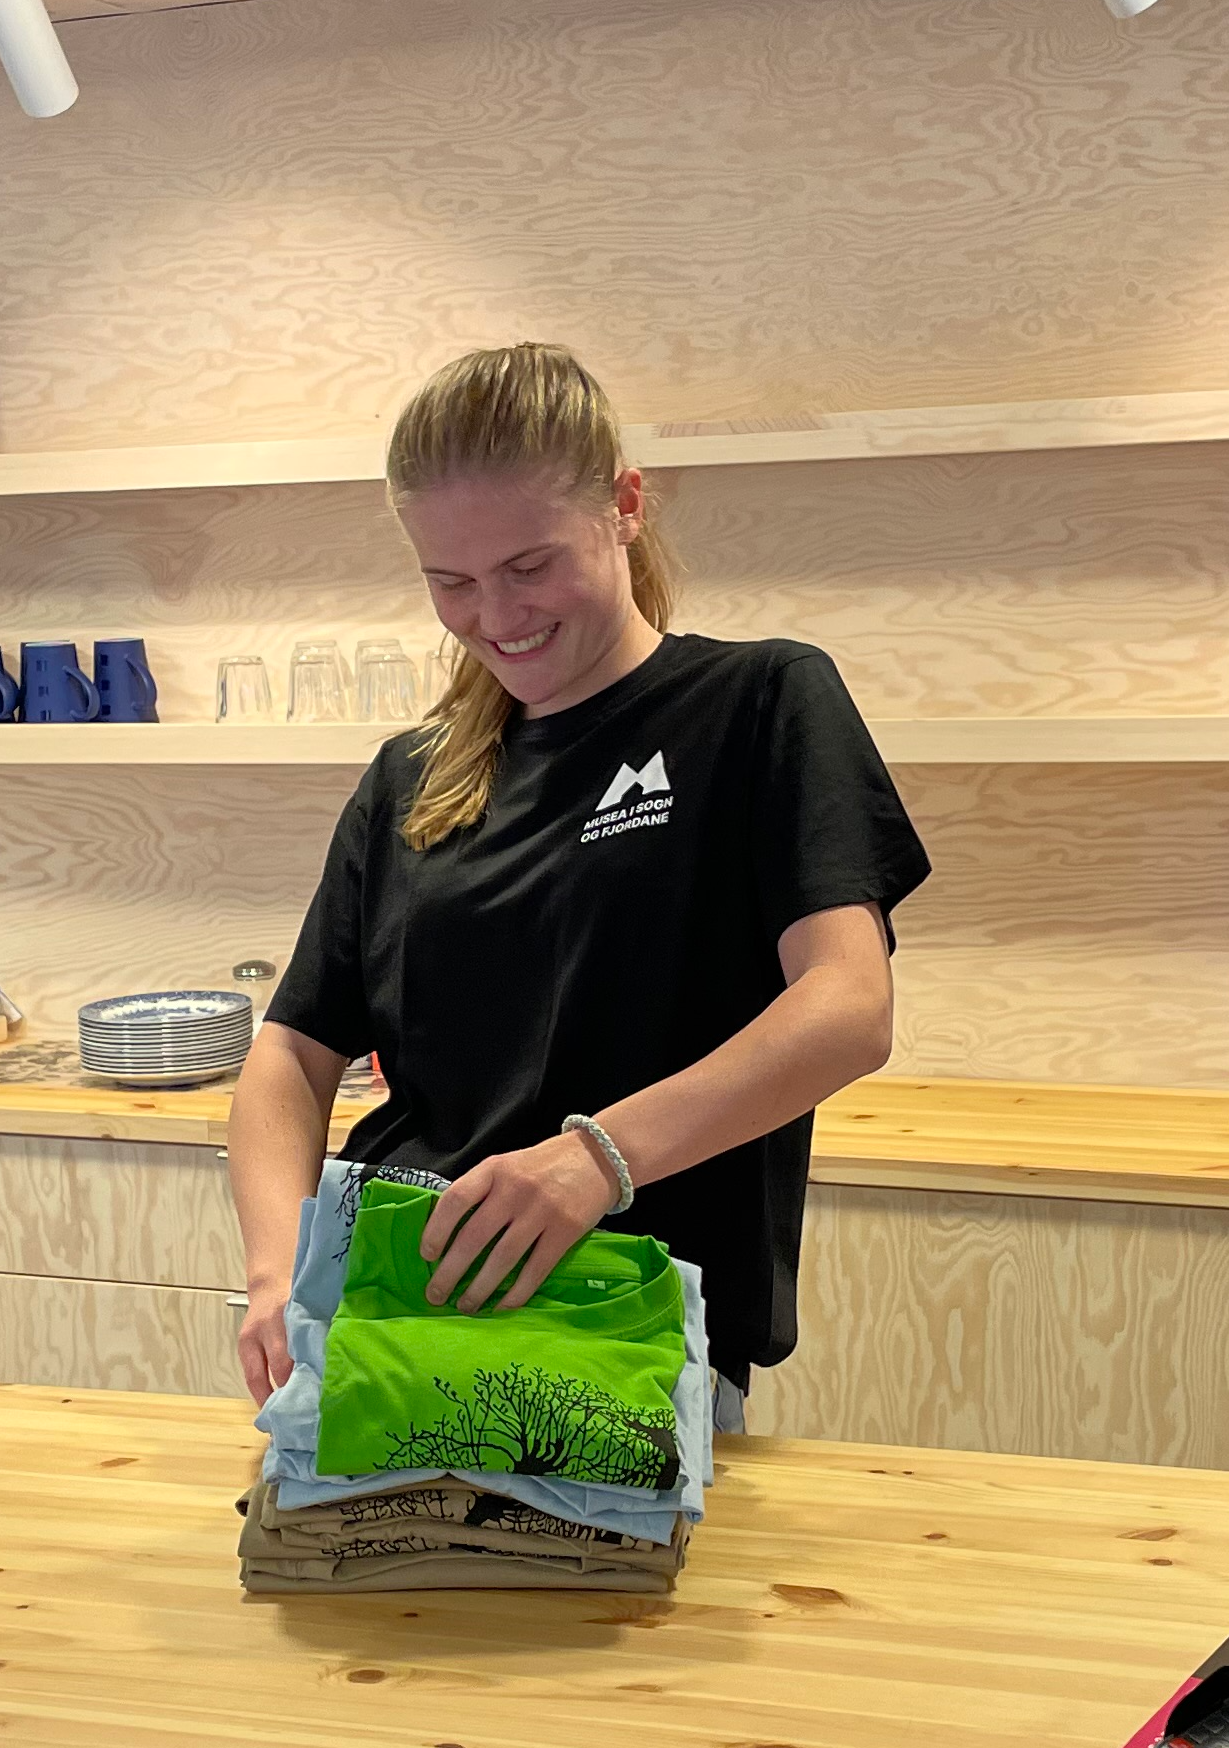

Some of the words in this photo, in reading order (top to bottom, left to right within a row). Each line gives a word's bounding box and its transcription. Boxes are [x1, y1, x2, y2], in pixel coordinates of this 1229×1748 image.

[580, 829, 600, 843] OG
[601, 812, 670, 837] FJORDANE
[583, 808, 627, 830] MUSEA
[629, 805, 635, 816] I
[635, 796, 674, 813] SOGN
